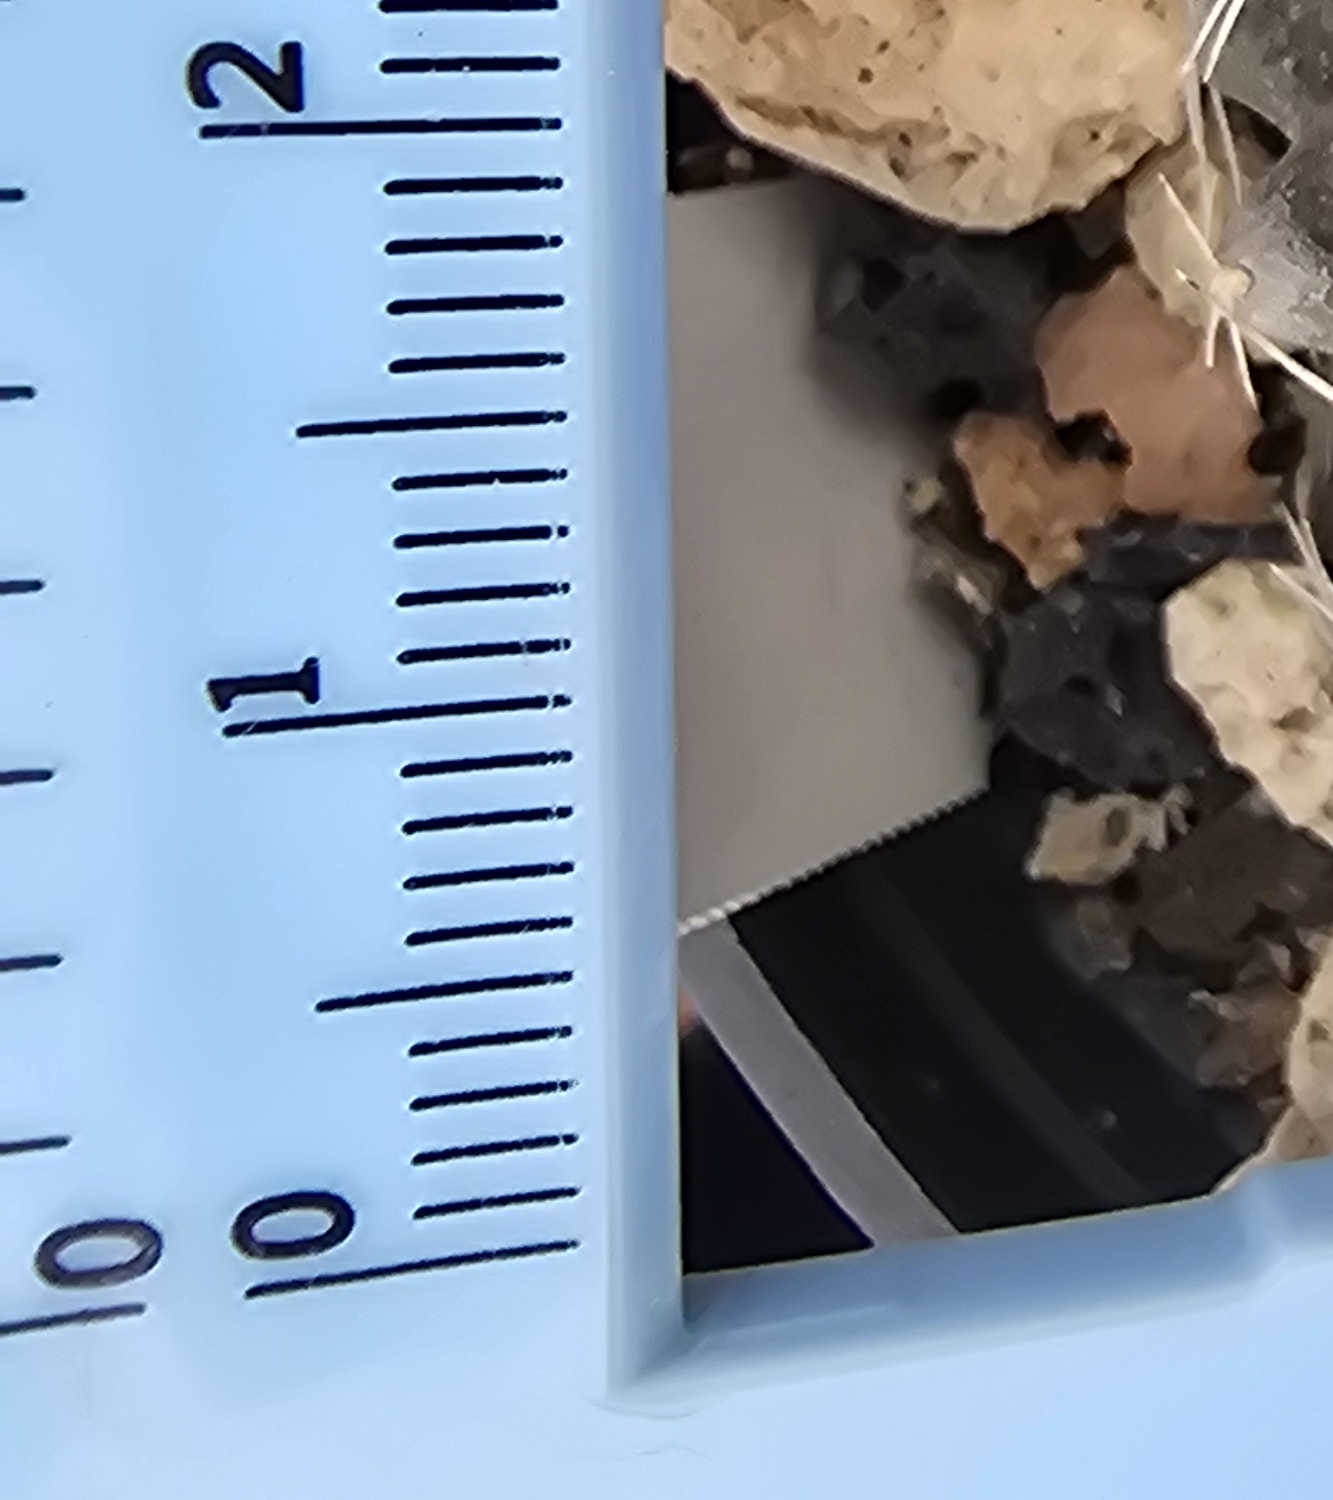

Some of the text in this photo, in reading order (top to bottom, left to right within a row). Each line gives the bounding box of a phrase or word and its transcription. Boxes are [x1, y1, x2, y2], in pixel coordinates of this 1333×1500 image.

[186, 41, 305, 114] 2
[206, 656, 321, 713] 1
[34, 1217, 165, 1289] 0
[231, 1190, 356, 1260] 0
